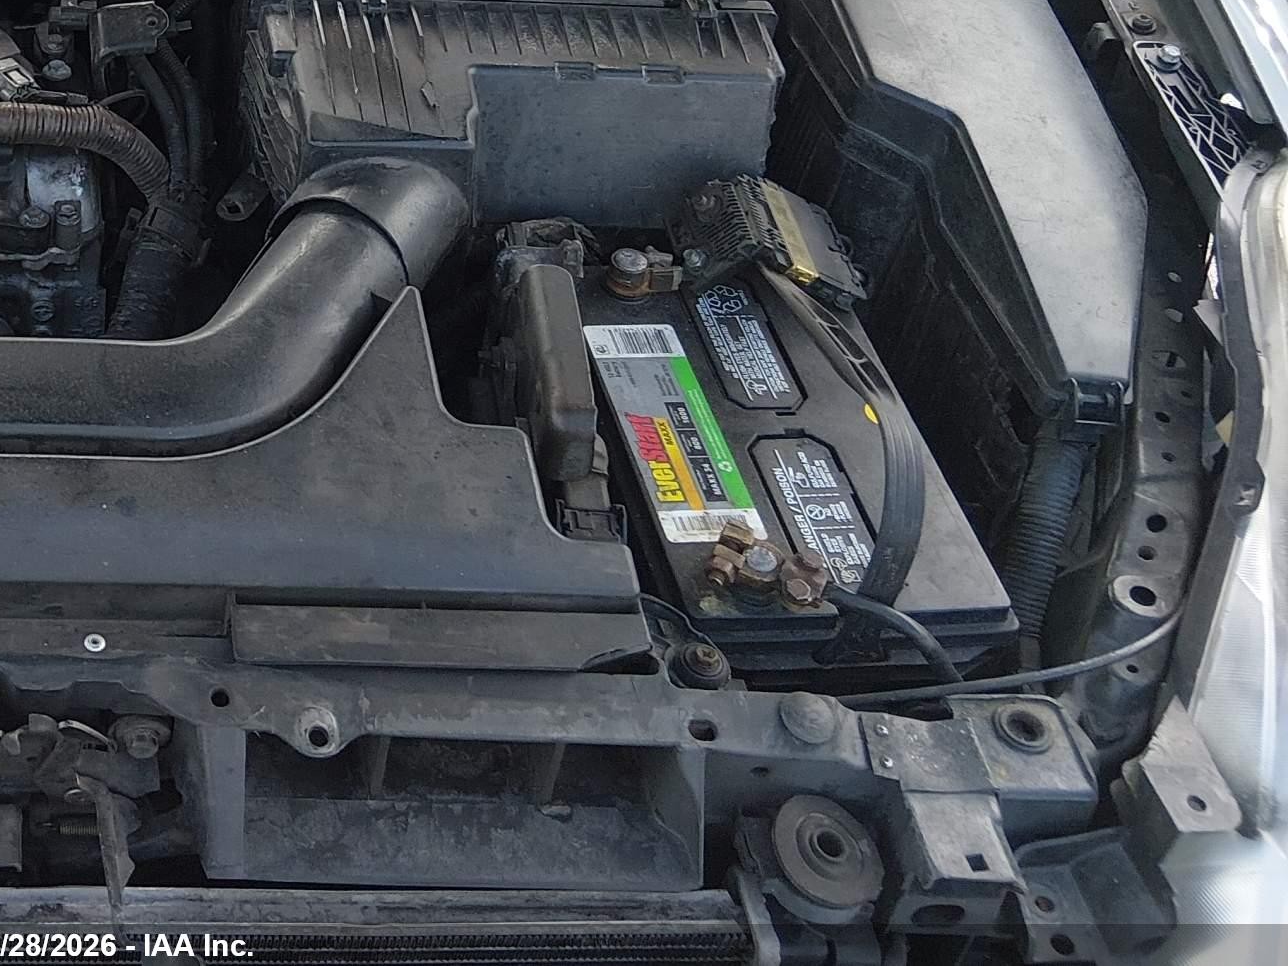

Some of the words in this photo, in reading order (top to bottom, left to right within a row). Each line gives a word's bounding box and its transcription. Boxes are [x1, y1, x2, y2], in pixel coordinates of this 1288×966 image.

[658, 421, 674, 446] MAXX
[625, 413, 686, 503] EverStart
[706, 473, 722, 495] MAXX
[772, 468, 798, 504] POISON
[794, 514, 822, 554] ANGER
